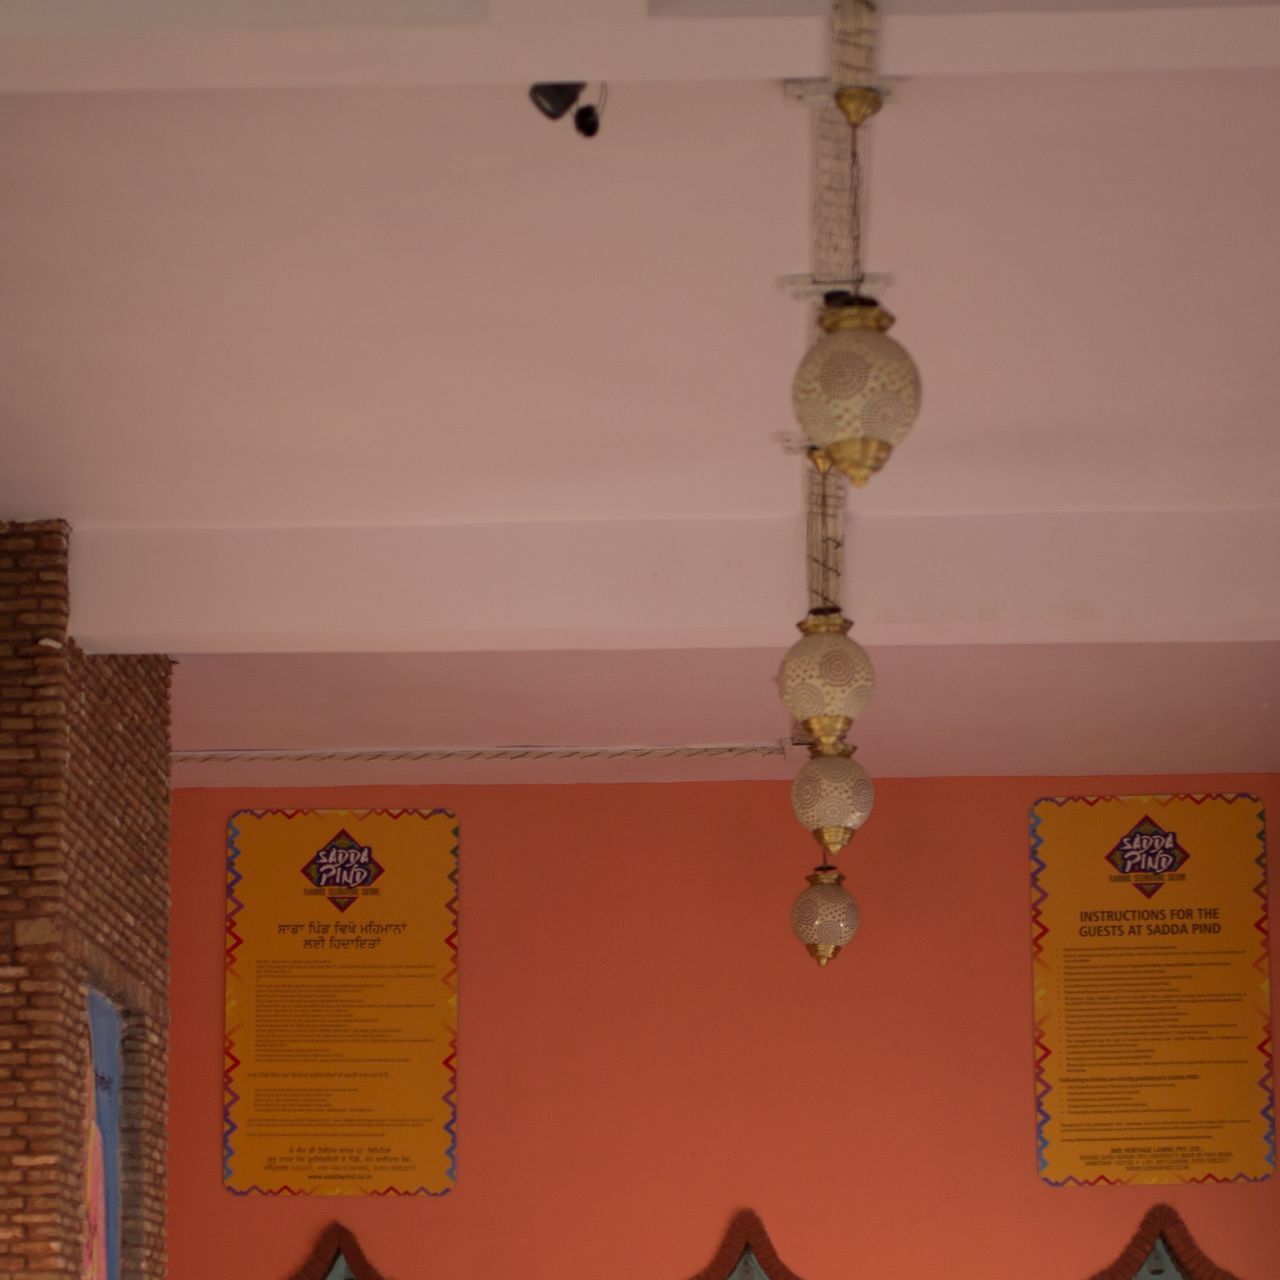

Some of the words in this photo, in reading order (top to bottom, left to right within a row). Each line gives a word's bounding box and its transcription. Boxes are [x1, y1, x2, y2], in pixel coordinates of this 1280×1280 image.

[1120, 833, 1174, 853] SADDA
[317, 847, 369, 867] SADDA
[1124, 849, 1173, 873] PIND
[319, 864, 368, 887] PIND
[1080, 909, 1166, 922] INSTRUCTIONS
[1170, 908, 1193, 920] FOR
[1197, 907, 1219, 919] THE
[277, 923, 304, 934] ਸਾਡਾ
[1079, 925, 1124, 937] GUESTS
[1128, 925, 1142, 936] AT
[1147, 924, 1188, 935] SADDA
[1192, 923, 1221, 934] PIND
